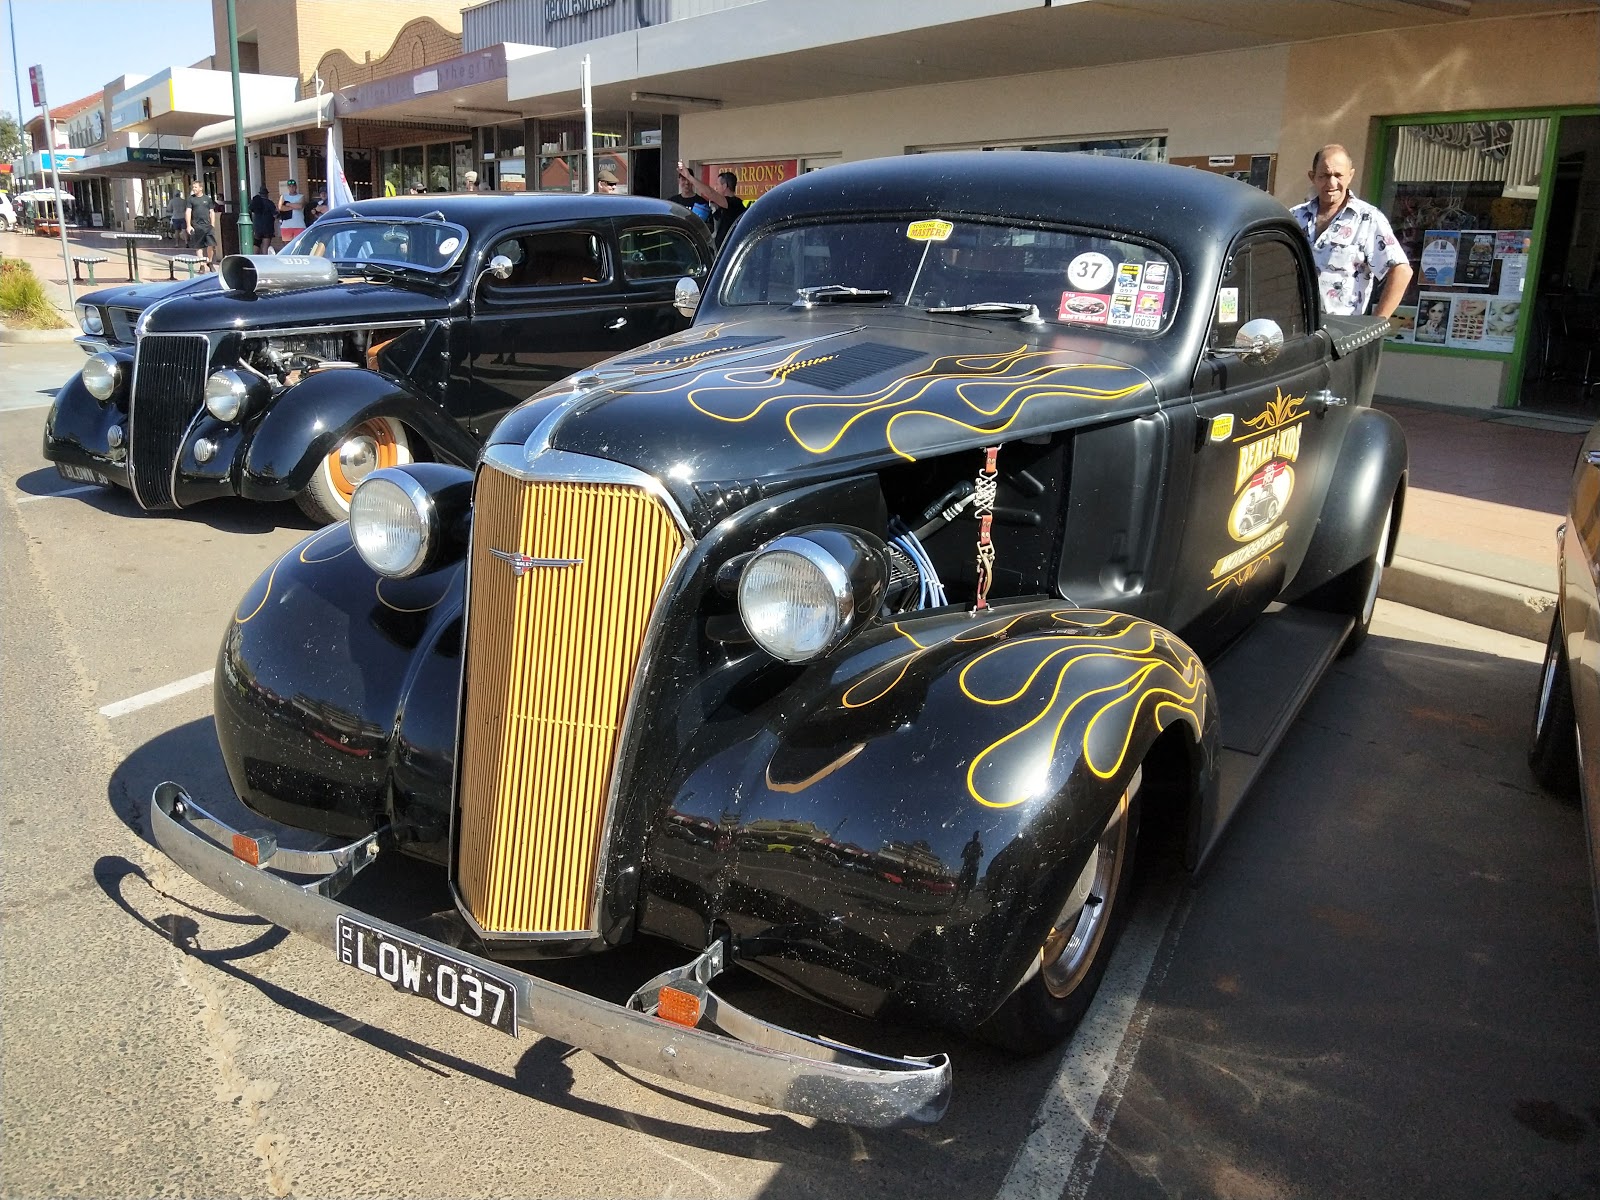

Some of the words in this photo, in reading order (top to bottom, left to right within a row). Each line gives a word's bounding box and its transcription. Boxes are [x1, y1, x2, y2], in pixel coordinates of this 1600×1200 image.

[275, 146, 367, 160] LBRRY
[911, 228, 946, 237] MASTERS
[1077, 261, 1102, 279] 37
[1135, 318, 1157, 328] 0037
[1277, 422, 1303, 462] KIDS
[64, 464, 96, 482] BLOWN
